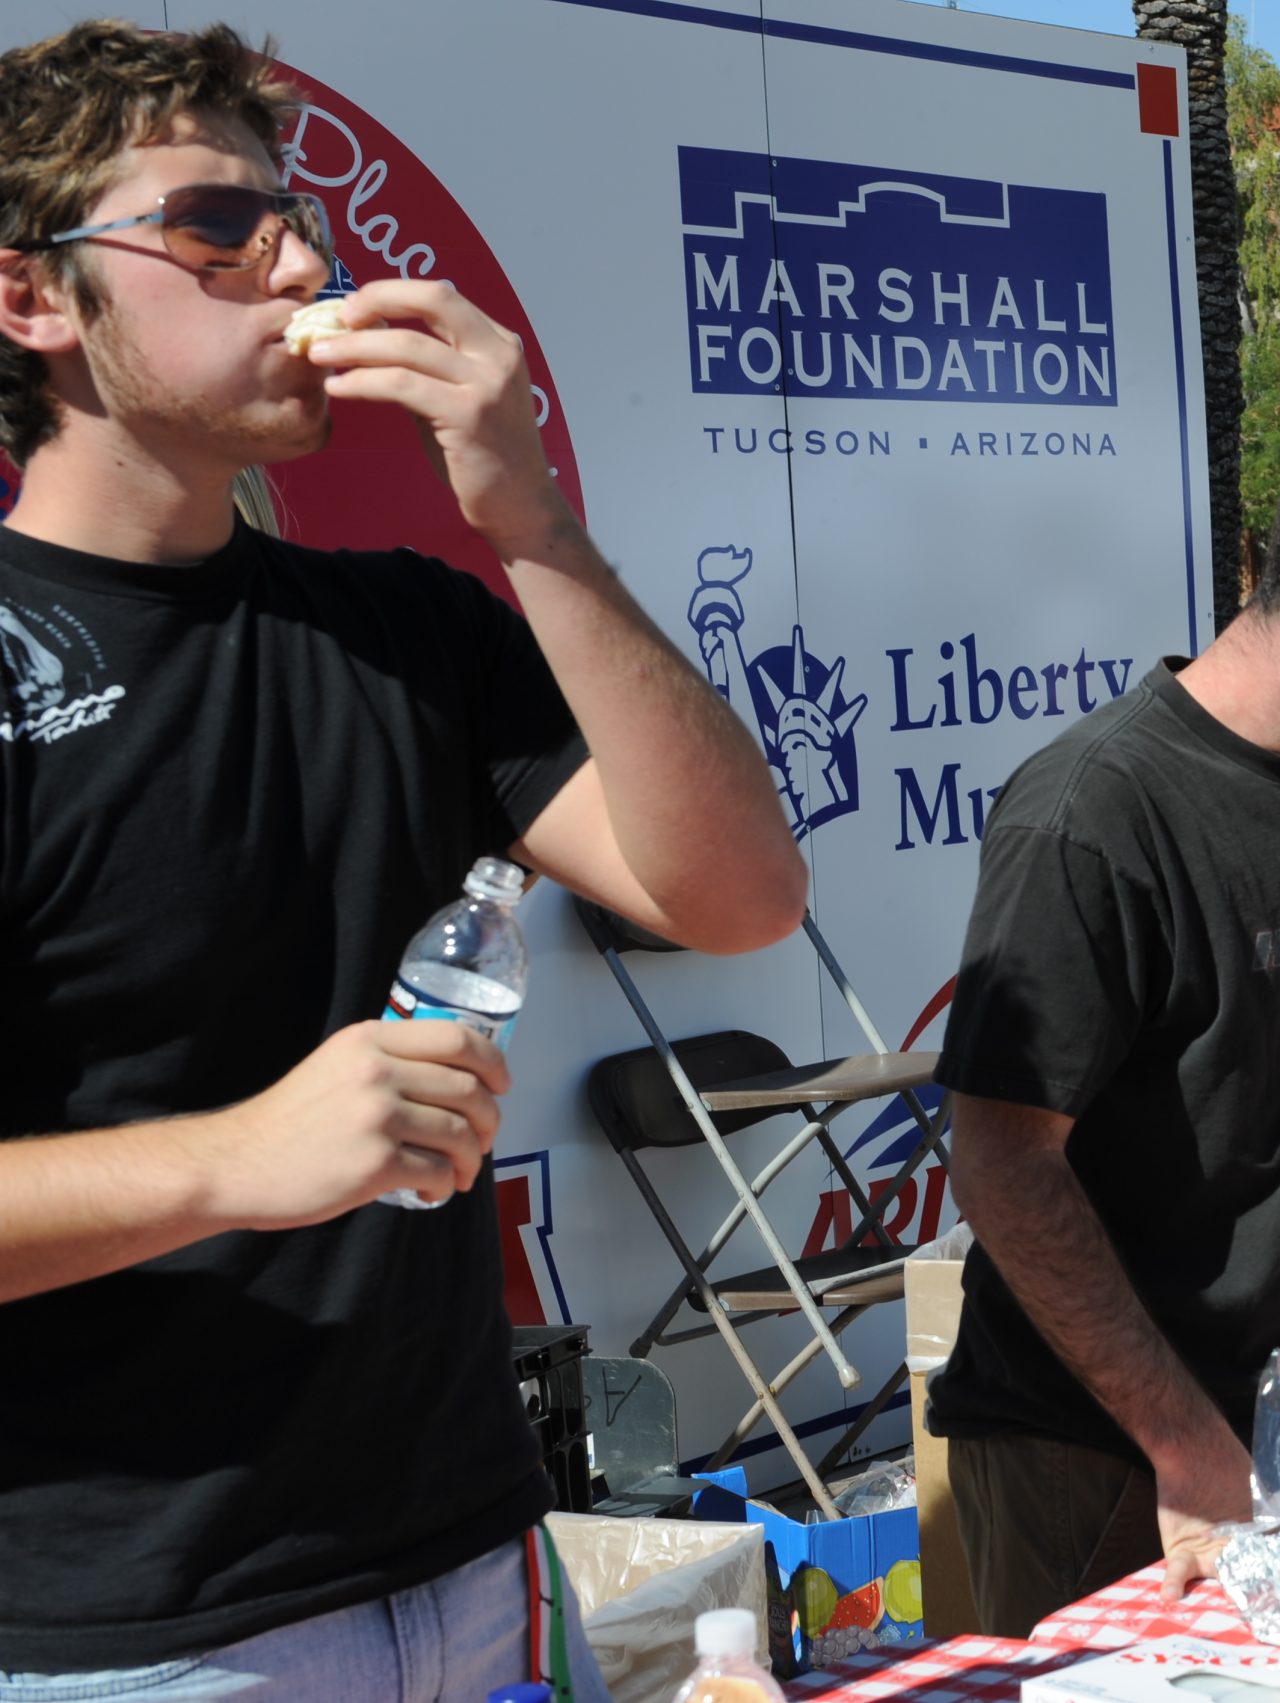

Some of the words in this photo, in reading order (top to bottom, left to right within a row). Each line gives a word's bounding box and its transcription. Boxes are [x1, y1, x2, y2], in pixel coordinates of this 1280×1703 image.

[278, 102, 456, 284] Plac
[692, 252, 1108, 336] MARSHALL
[696, 324, 1112, 397] FOUNDATION
[703, 426, 892, 456] TUCSON
[950, 431, 1118, 457] ARIZONA
[0, 684, 126, 742] inano
[885, 632, 1134, 732] Liberty
[894, 762, 1003, 851] Mu
[800, 1164, 950, 1261] ARI
[1115, 1653, 1280, 1667] SYSCO
